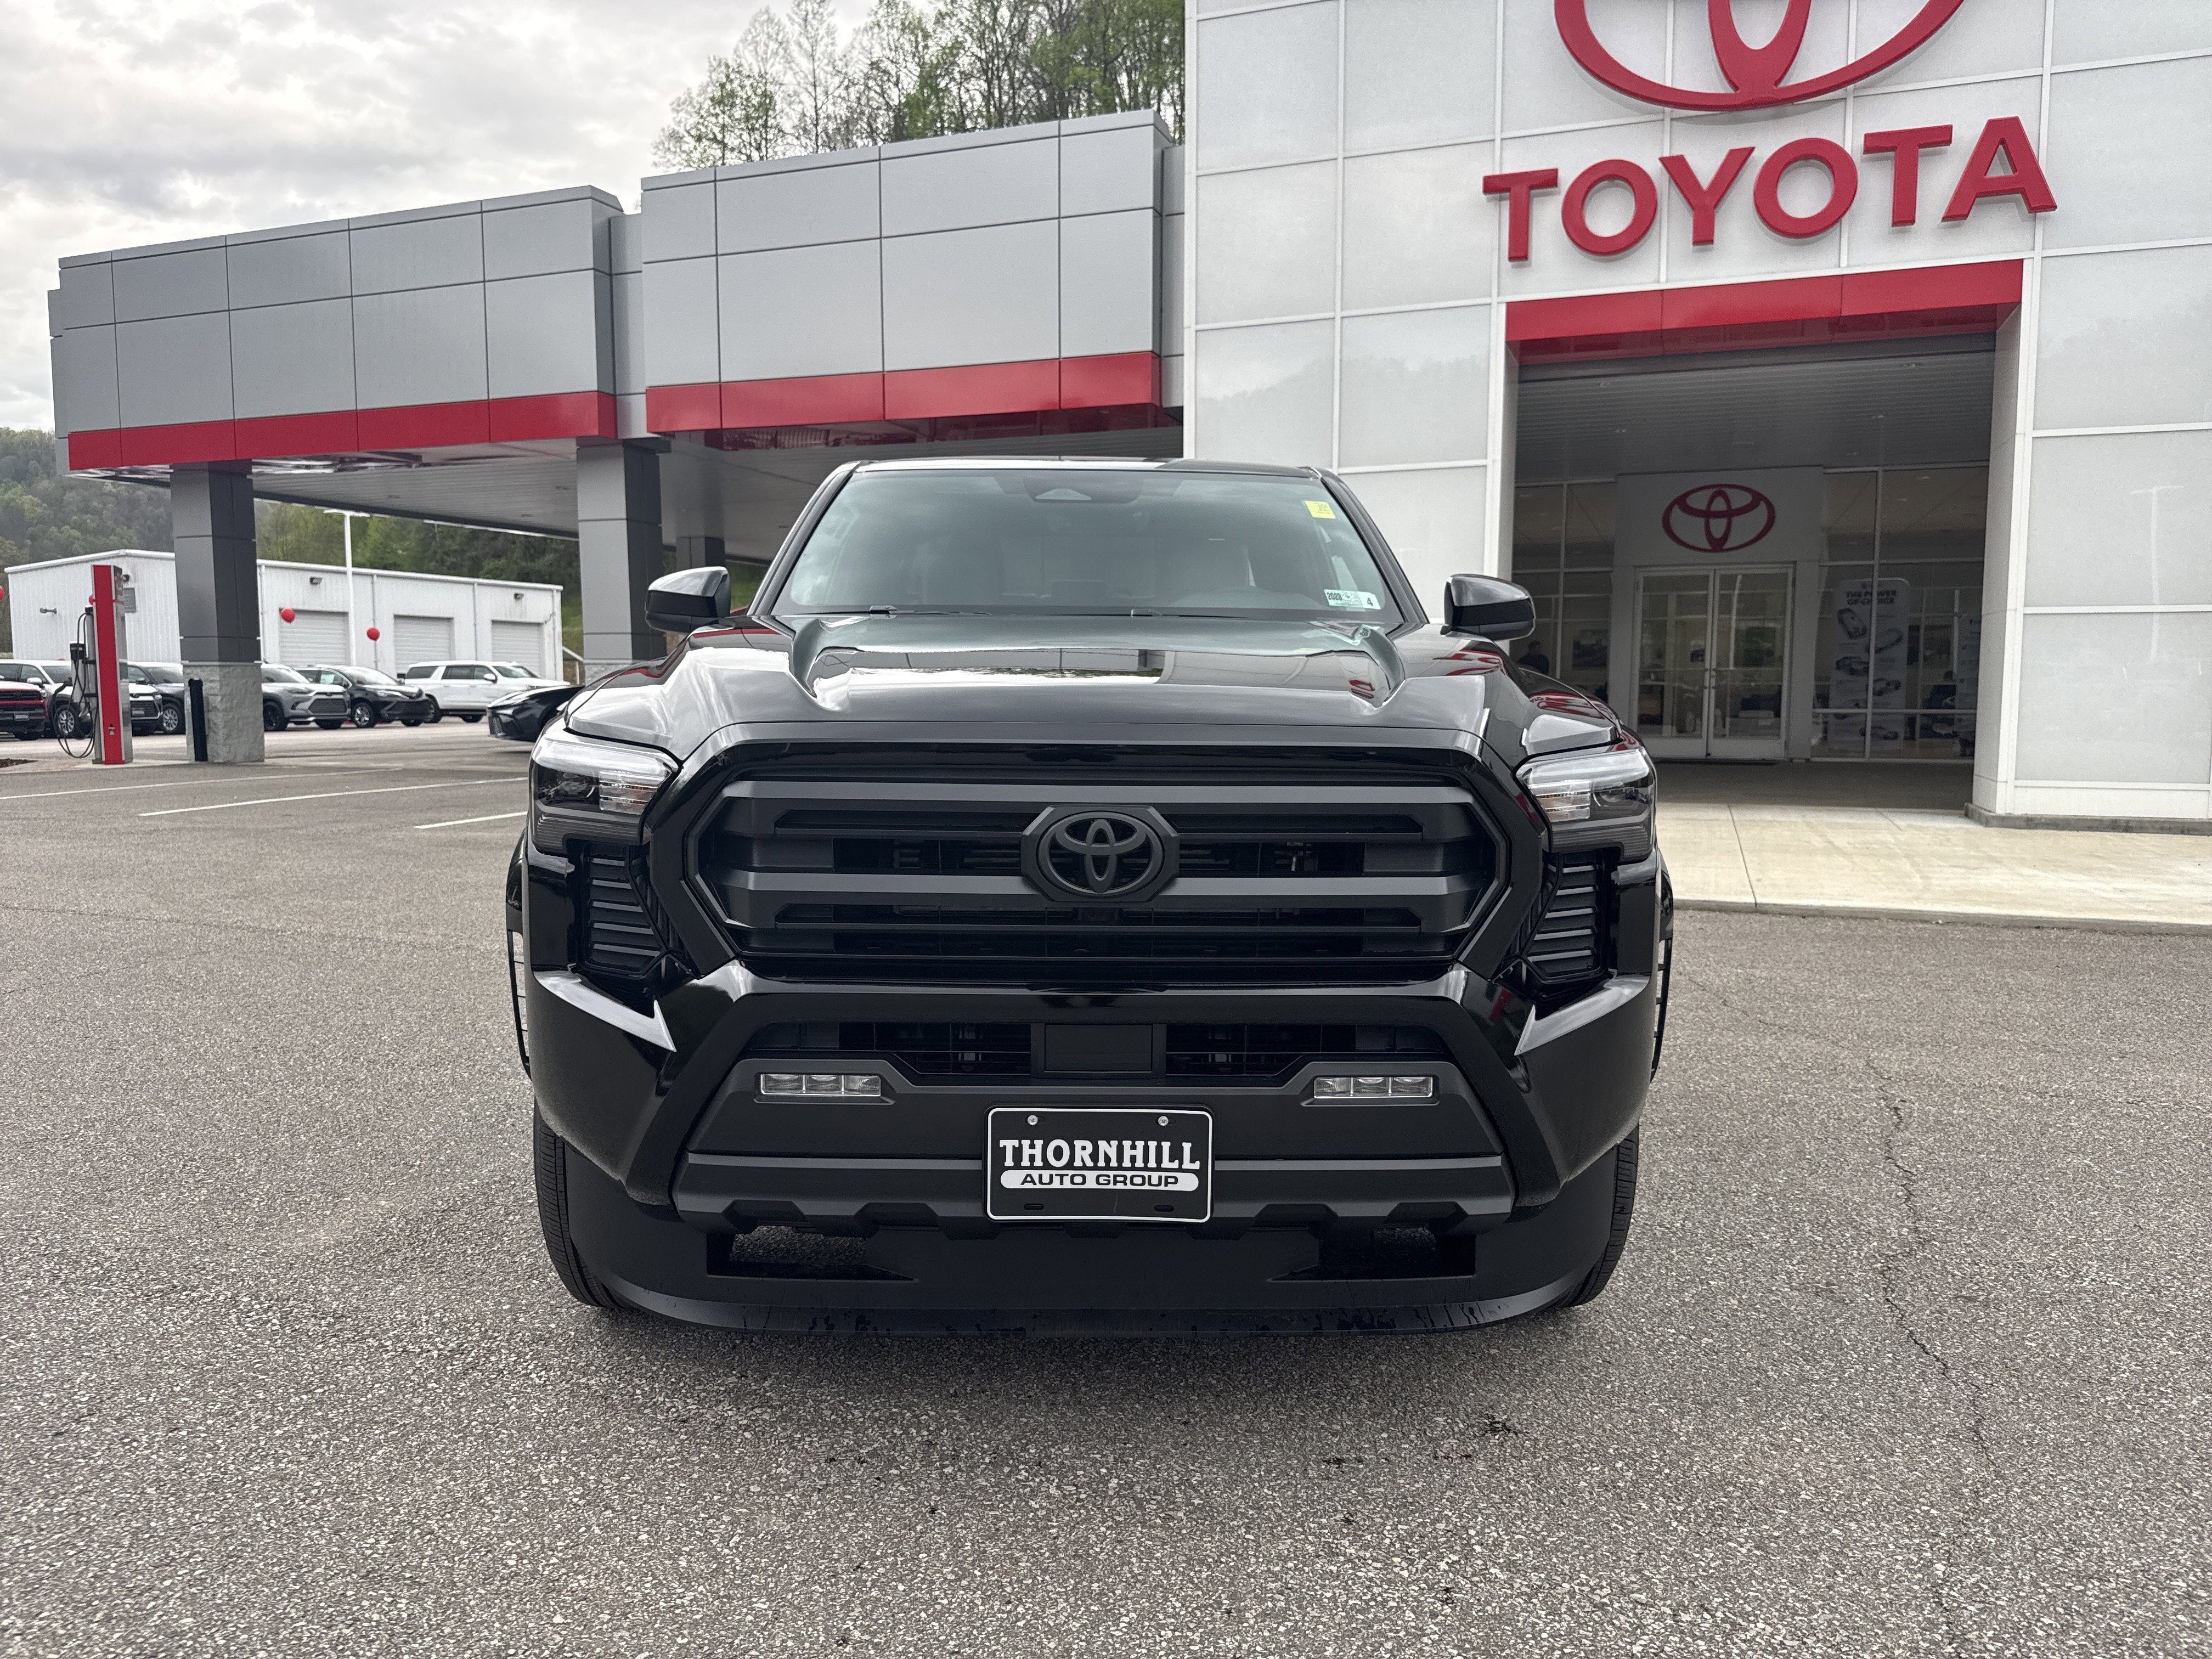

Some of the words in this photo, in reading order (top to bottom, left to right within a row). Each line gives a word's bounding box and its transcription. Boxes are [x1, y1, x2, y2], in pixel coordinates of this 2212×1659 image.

[1482, 116, 2057, 262] TOYOTA
[1367, 597, 1373, 606] 4
[999, 1139, 1200, 1170] THORNHILL
[1020, 1173, 1086, 1186] AUTO
[1095, 1173, 1178, 1187] GROUP
